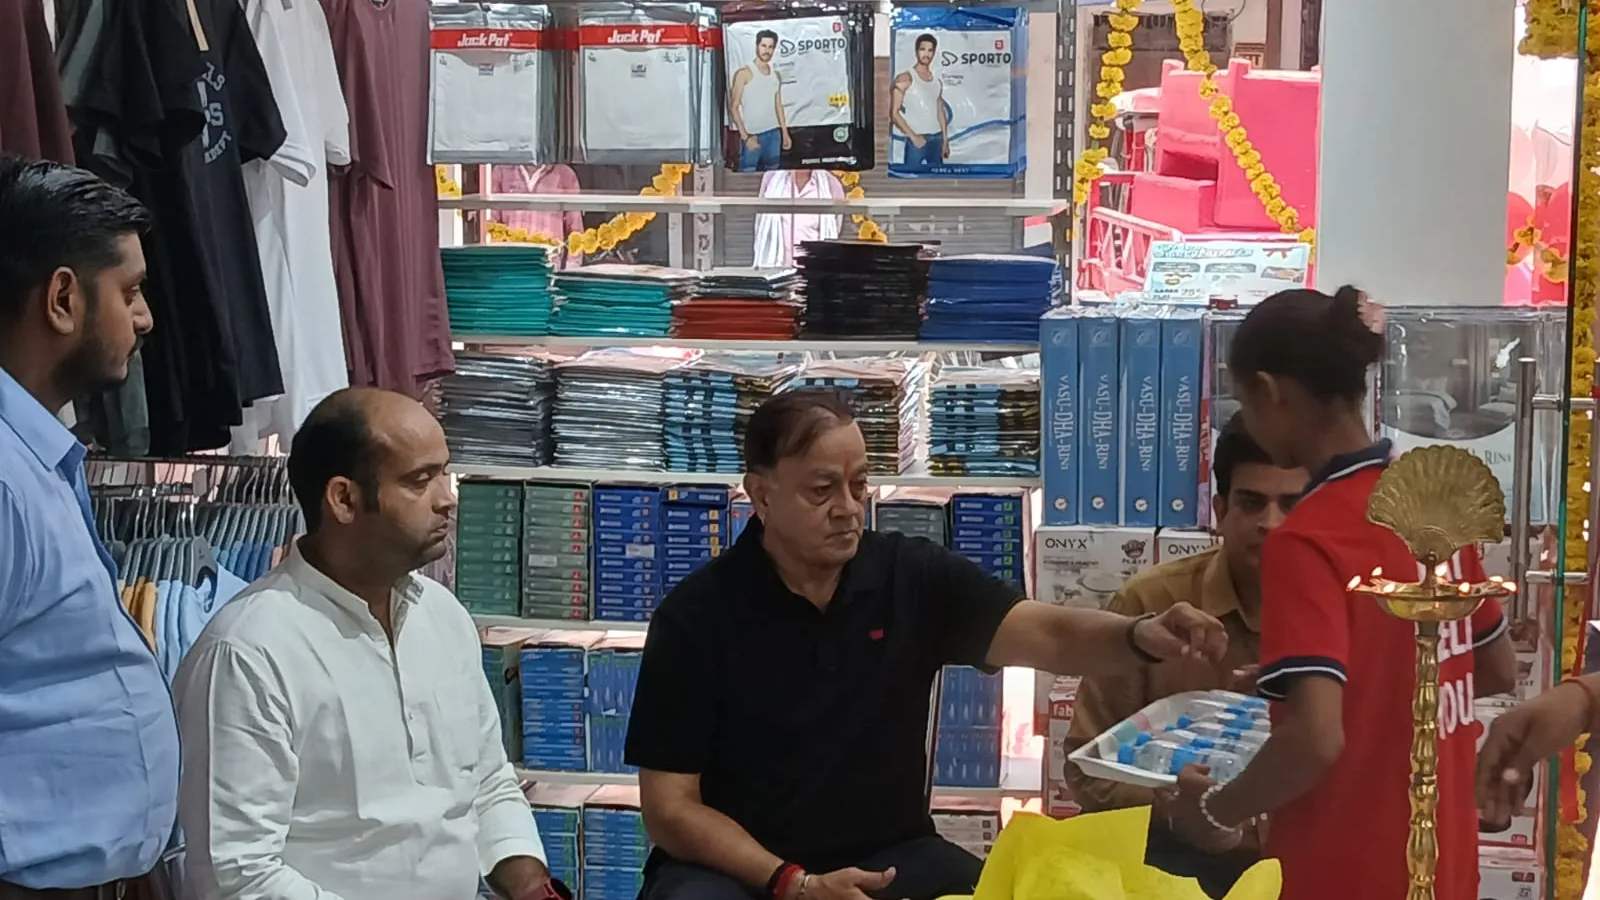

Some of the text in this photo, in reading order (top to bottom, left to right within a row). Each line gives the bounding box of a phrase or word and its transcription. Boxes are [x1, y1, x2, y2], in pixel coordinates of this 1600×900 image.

[457, 33, 487, 47] Jack
[607, 29, 639, 43] Jack
[798, 38, 846, 51] SPORTO
[961, 53, 1012, 65] SPORTO
[1045, 537, 1088, 549] ONYX
